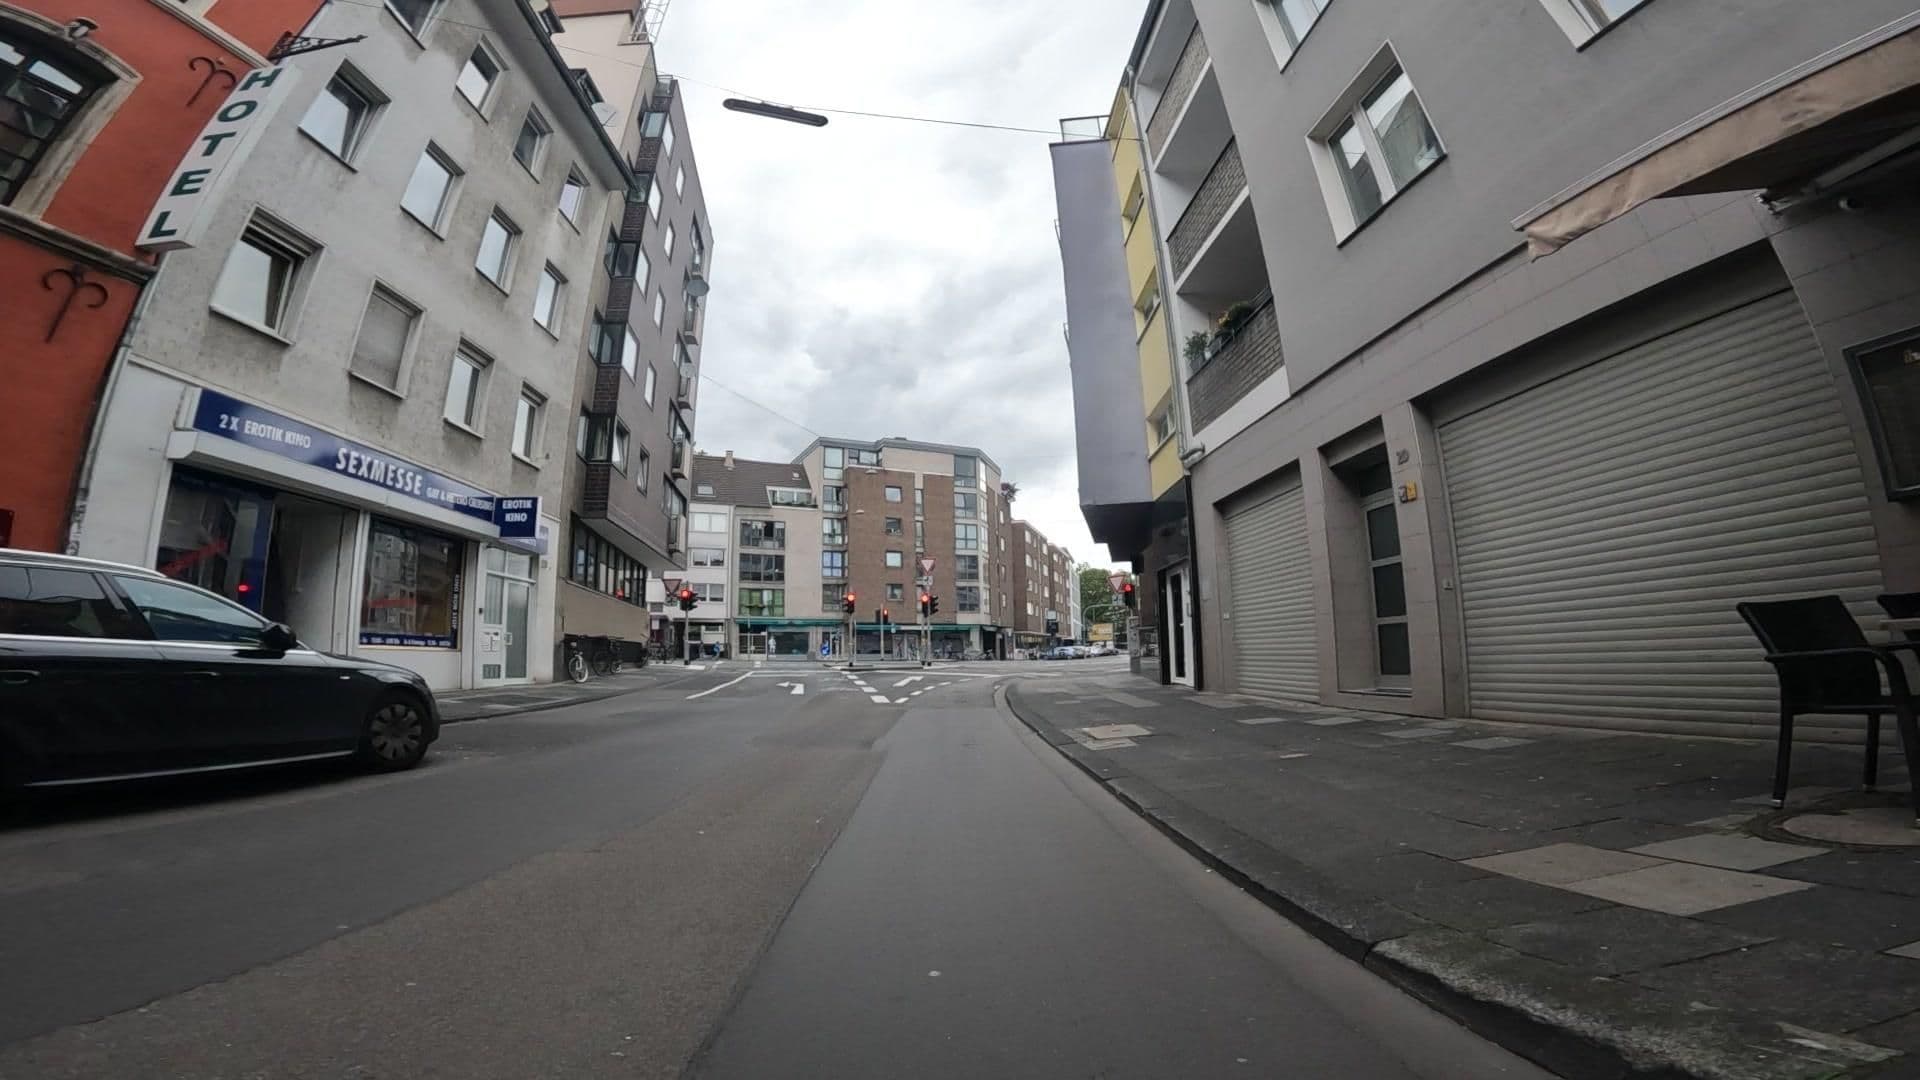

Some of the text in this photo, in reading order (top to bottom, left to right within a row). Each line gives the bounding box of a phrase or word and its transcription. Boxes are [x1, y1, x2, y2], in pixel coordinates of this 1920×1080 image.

[149, 67, 282, 238] HOTEL
[218, 413, 312, 449] 2 X EROTIK KINO
[335, 447, 423, 495] SEXMESSE
[502, 499, 532, 510] EROTIK
[505, 512, 528, 522] KINO
